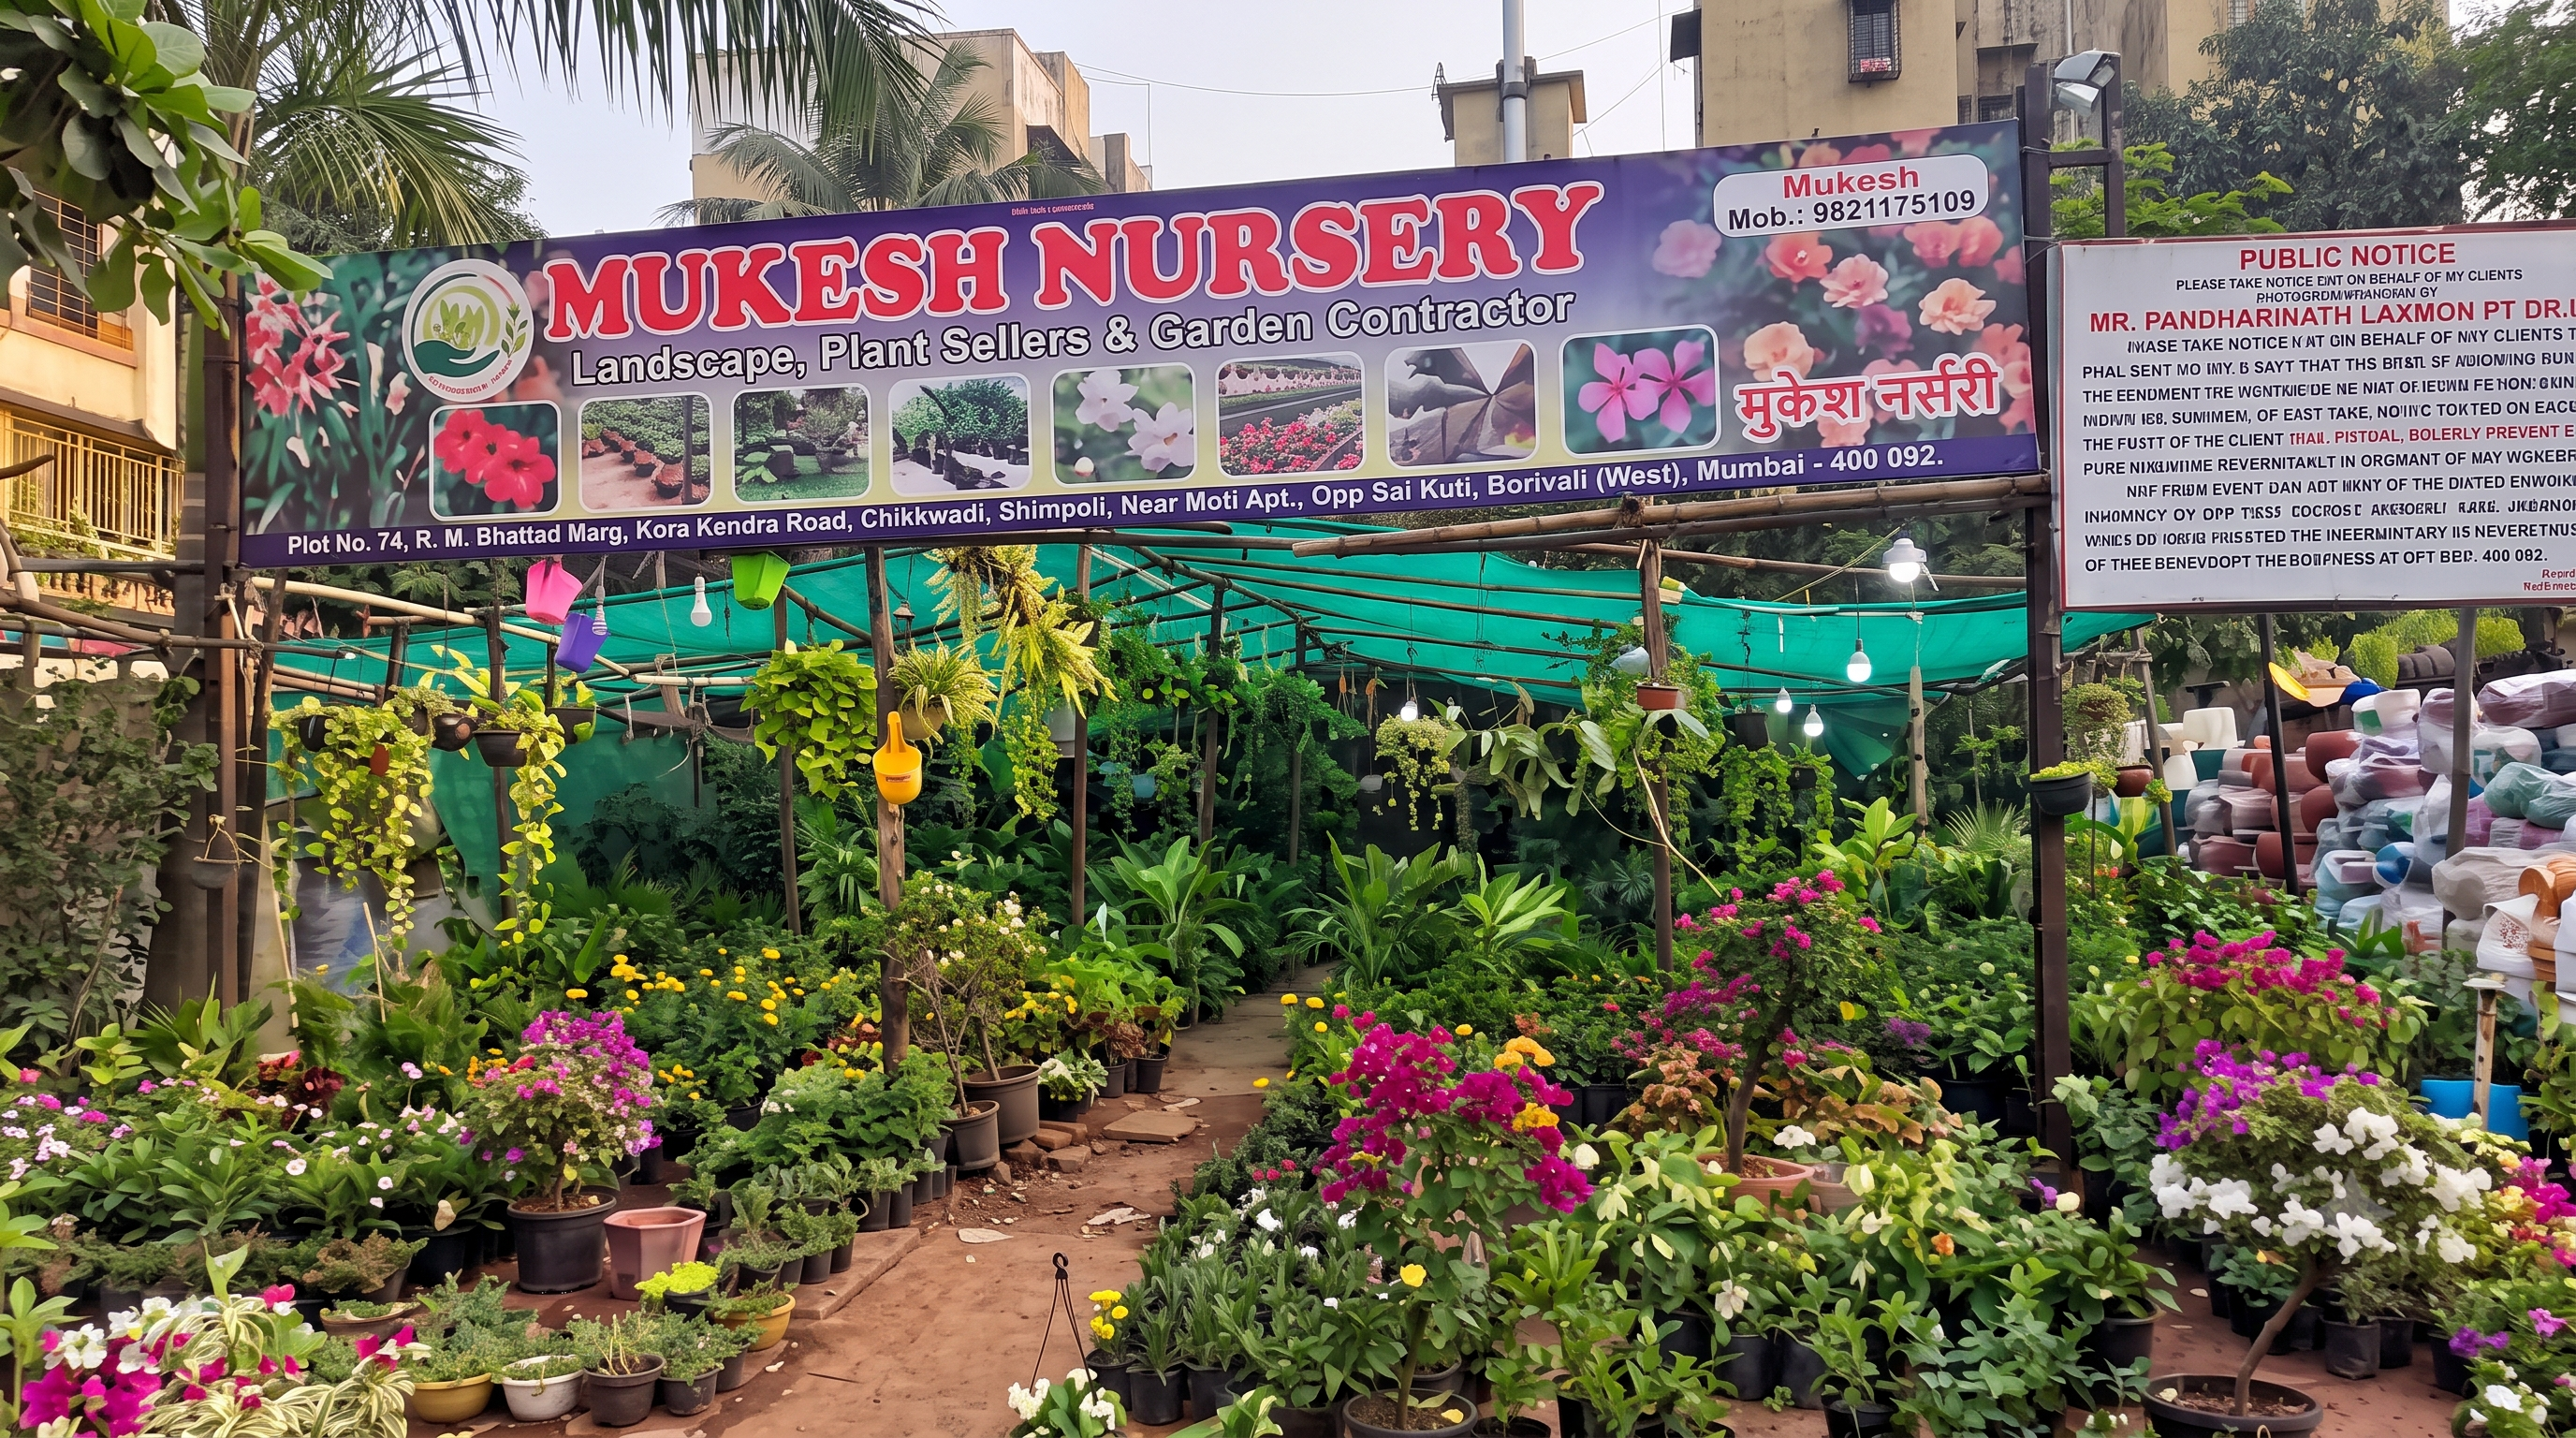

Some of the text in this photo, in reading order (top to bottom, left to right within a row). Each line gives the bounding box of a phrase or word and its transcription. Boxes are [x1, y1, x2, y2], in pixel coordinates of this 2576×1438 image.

[1783, 166, 1919, 198] Mukesh
[1728, 189, 1976, 230] Mob.: 9821175109
[546, 184, 1601, 340] MUKESH NURSERY
[2240, 242, 2456, 271] PUBLIC NOTICE
[2176, 278, 2226, 291] PLEASE
[2228, 277, 2262, 289] TAKE
[2266, 275, 2314, 288] NOTICE
[2347, 273, 2365, 286] ON
[2369, 271, 2422, 285] BEHALF
[2423, 271, 2442, 283] OF
[2445, 271, 2465, 283] MY
[2467, 269, 2523, 282] CLIENTS
[2420, 286, 2438, 299] GY
[2090, 312, 2135, 332] MR.
[2145, 305, 2351, 330] PANDHARINATH
[2361, 301, 2474, 325] LAXMON
[2483, 300, 2516, 320] PT
[570, 288, 1576, 387] Landscape, Plant Sellers & Garden Contractor
[2181, 337, 2224, 352] TAKE
[2228, 335, 2289, 351] NOTICE
[2361, 331, 2426, 346] BEHALF
[2430, 330, 2453, 345] OF
[2494, 327, 2564, 343] CLIENTS
[2083, 365, 2127, 379] PHAL
[2130, 363, 2173, 378] SENT
[2176, 362, 2202, 376] MO
[2254, 360, 2295, 374] SAYT
[2298, 358, 2341, 373] THAT
[2344, 357, 2378, 372] THS
[2431, 355, 2451, 369] SF
[1738, 358, 1998, 438] मुकेश नर्सरी
[2082, 389, 2113, 404] THE
[2116, 387, 2202, 403] EENDMENT
[2203, 386, 2234, 400] TRE
[2473, 378, 2495, 391] FE
[2257, 408, 2279, 422] OF
[2283, 407, 2323, 421] EAST
[2327, 405, 2373, 421] TAKE,
[2506, 401, 2530, 415] ON
[2082, 437, 2114, 452] THE
[2117, 436, 2166, 450] FUSTT
[2169, 435, 2191, 449] OF
[2193, 434, 2224, 448] THE
[2228, 433, 2285, 448] CLIENT
[2334, 430, 2405, 445] PISTOAL,
[2408, 427, 2481, 442] BOLERLY
[2485, 424, 2560, 439] PREVENT
[2084, 462, 2126, 477] PURE
[2340, 454, 2356, 468] IN
[2361, 452, 2441, 468] ORGMANT
[2445, 451, 2466, 465] OF
[2471, 450, 2503, 465] MAY
[288, 535, 330, 555] Plot
[336, 533, 372, 552] No.
[377, 525, 409, 553] 74,
[416, 529, 438, 549] R.
[445, 527, 470, 548] M.
[476, 523, 561, 547] Bhattad
[568, 522, 628, 546] Marg,
[637, 520, 690, 540] Kora
[696, 514, 779, 537] Kendra
[786, 510, 853, 533] Road,
[860, 502, 992, 529] Chikkwadi,
[999, 496, 1113, 523] Shimpoli,
[1121, 494, 1178, 515] Near
[1185, 489, 1238, 512] Moti
[1245, 488, 1304, 514] Apt.,
[1311, 484, 1364, 509] Opp
[1371, 479, 1412, 503] Sai
[1420, 476, 1479, 501] Kuti,
[1487, 468, 1588, 496] Borivali
[1596, 462, 1689, 491] (West),
[1697, 453, 1805, 481] Mumbai
[1830, 448, 1879, 472] 400
[1887, 444, 1943, 468] 092.
[2212, 481, 2264, 496] EVENT
[2269, 480, 2302, 494] DAN
[2386, 477, 2408, 492] OF
[2411, 477, 2444, 491] THE
[2174, 507, 2196, 521] OY
[2290, 528, 2322, 542] THE
[2085, 558, 2107, 572] OF
[2110, 557, 2152, 571] THEE
[2155, 554, 2252, 570] BENEVDOPT
[2255, 553, 2287, 568] THE
[2378, 551, 2400, 565] AT
[2481, 549, 2510, 563] 400
